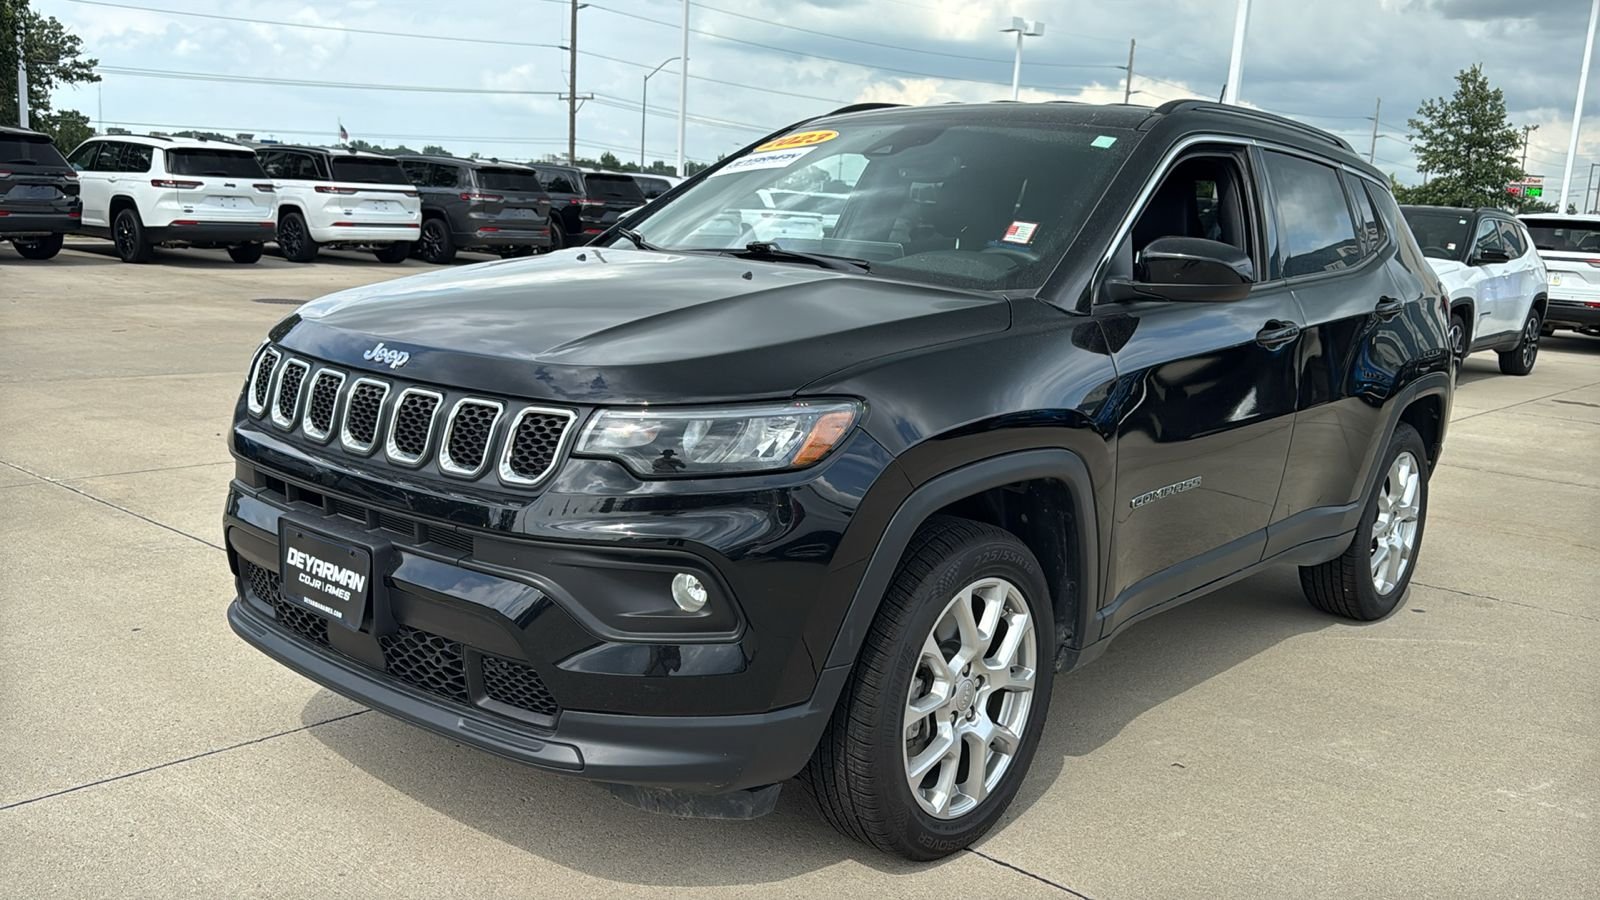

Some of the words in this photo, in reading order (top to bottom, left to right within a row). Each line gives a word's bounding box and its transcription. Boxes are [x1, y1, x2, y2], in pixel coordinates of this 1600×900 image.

[363, 342, 410, 369] Jeep
[1130, 475, 1203, 509] COMPASS
[286, 546, 366, 593] DEYARMAN
[324, 583, 351, 601] AMES
